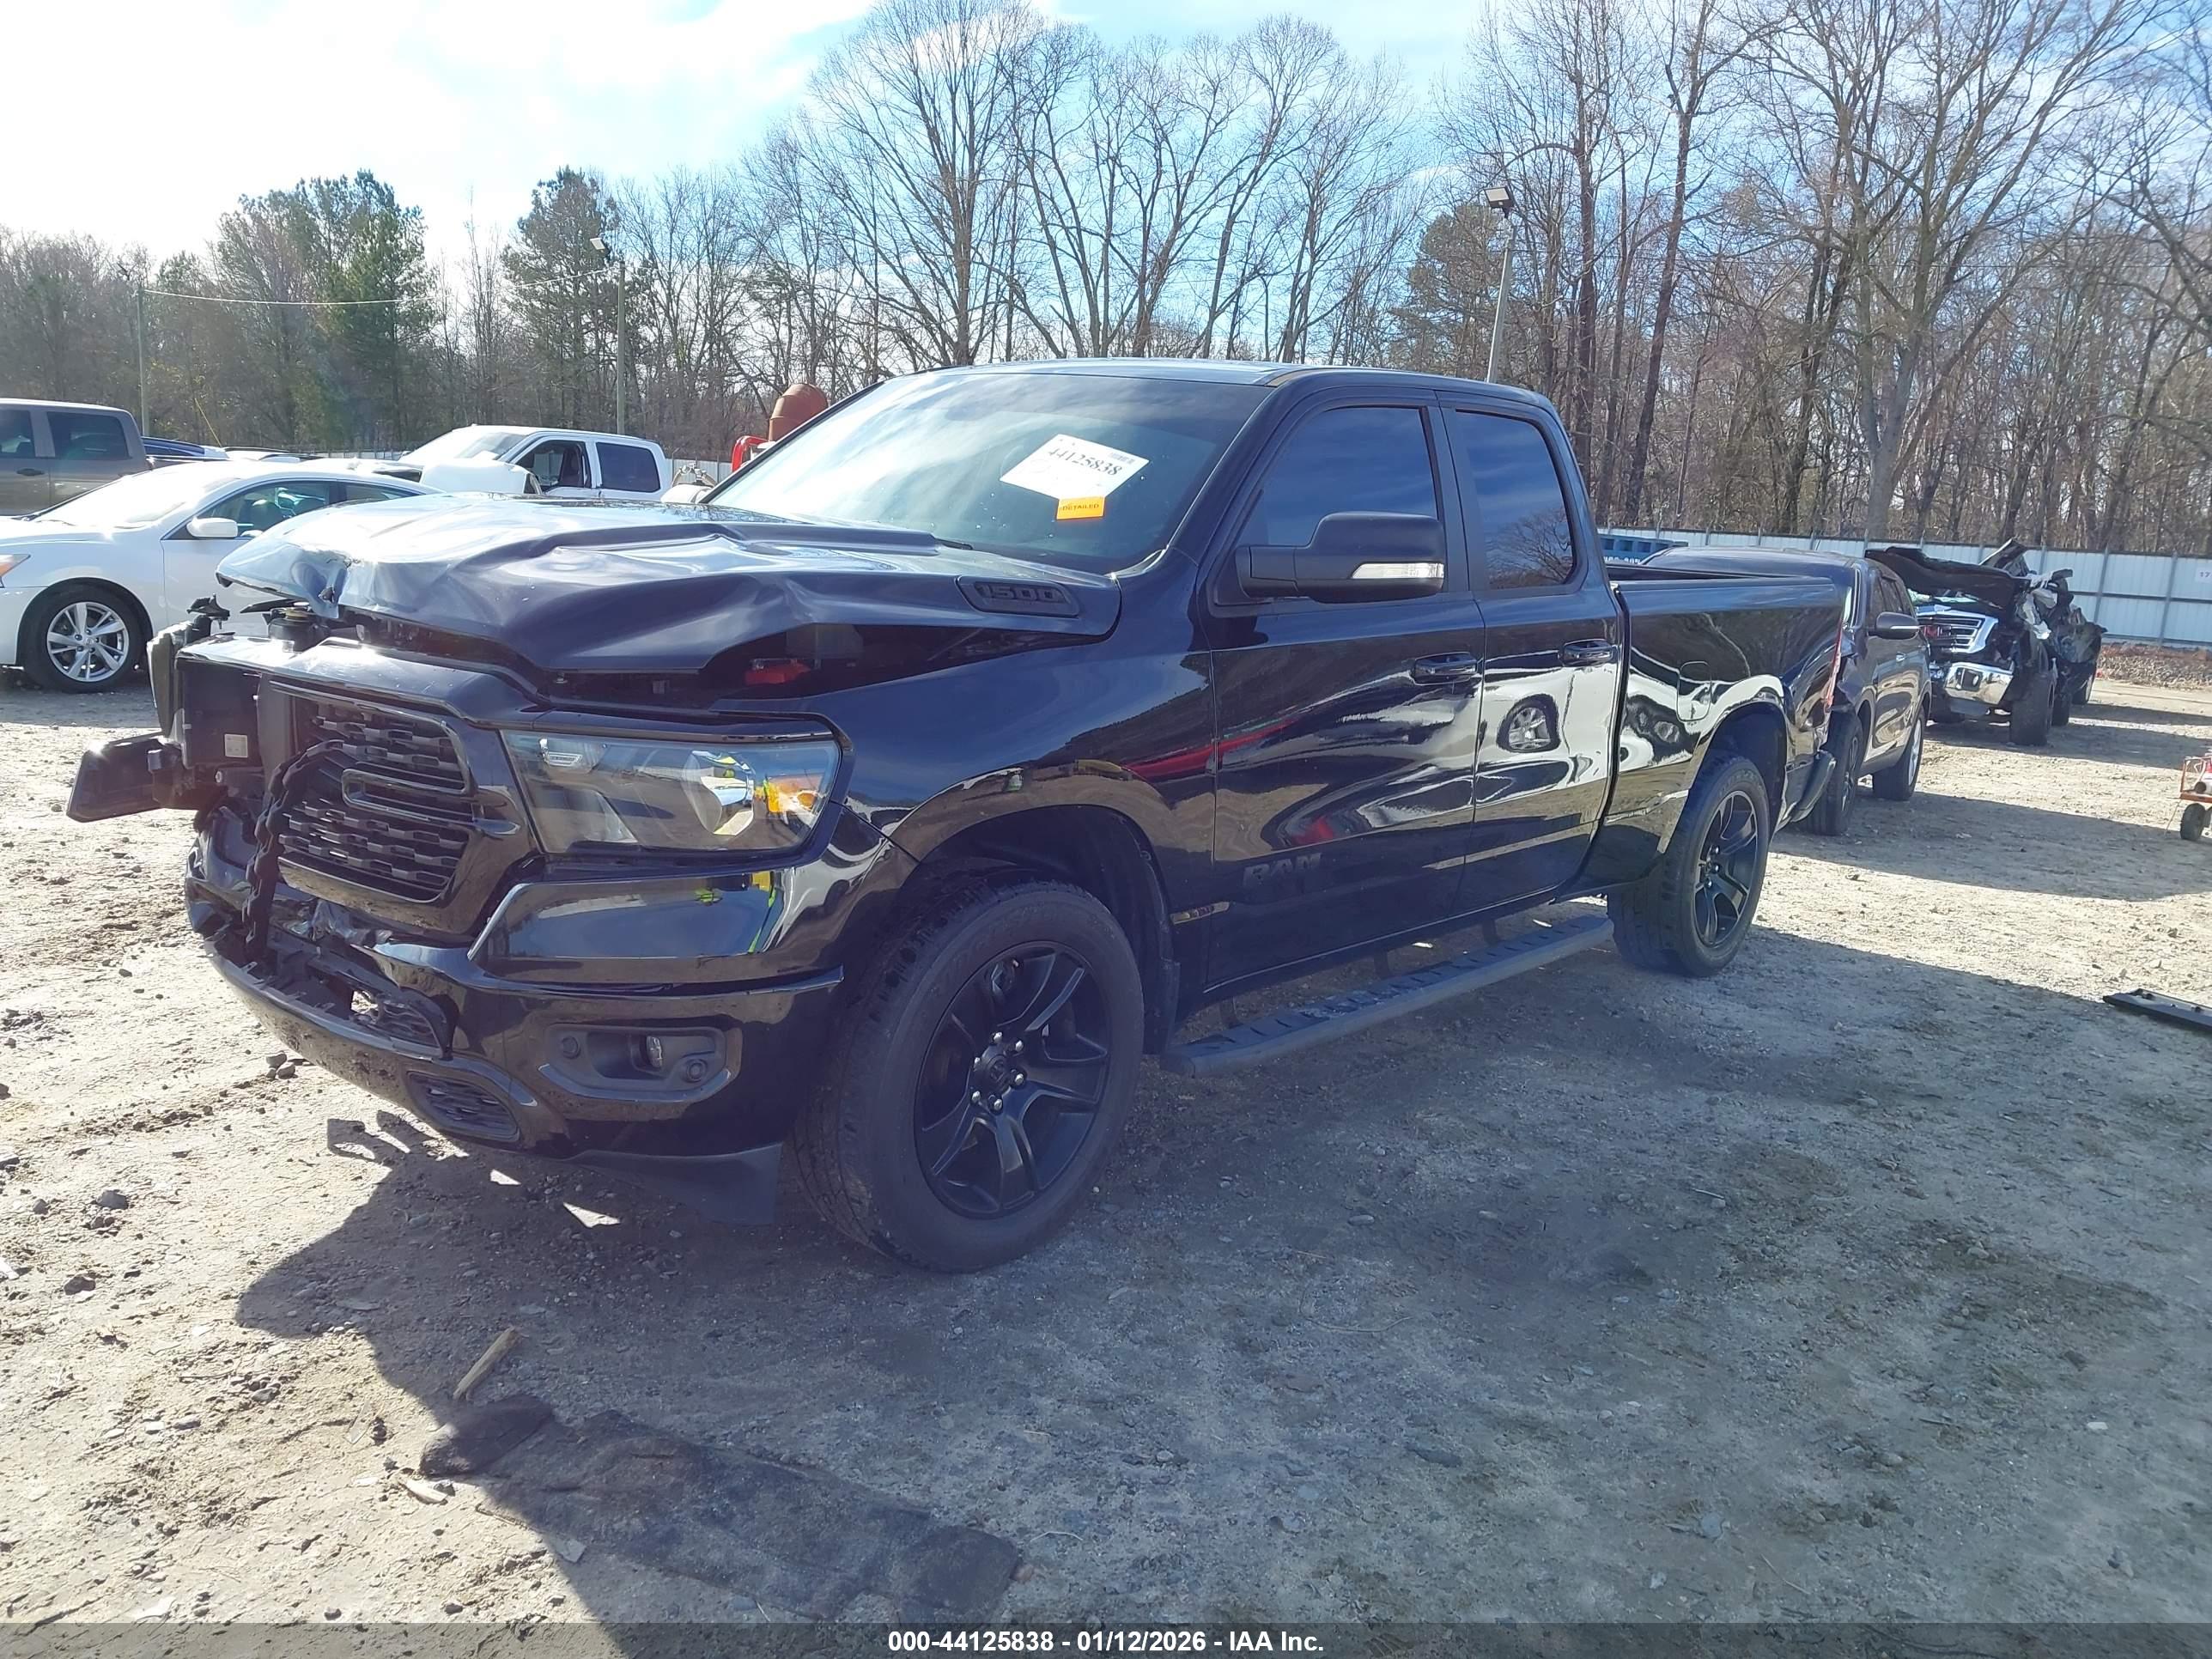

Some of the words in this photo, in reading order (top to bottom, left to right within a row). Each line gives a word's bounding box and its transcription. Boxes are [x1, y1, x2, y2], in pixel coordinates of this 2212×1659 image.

[1048, 447, 1123, 476] 44125838
[977, 583, 1062, 602] 1500
[1243, 852, 1322, 887] RAM
